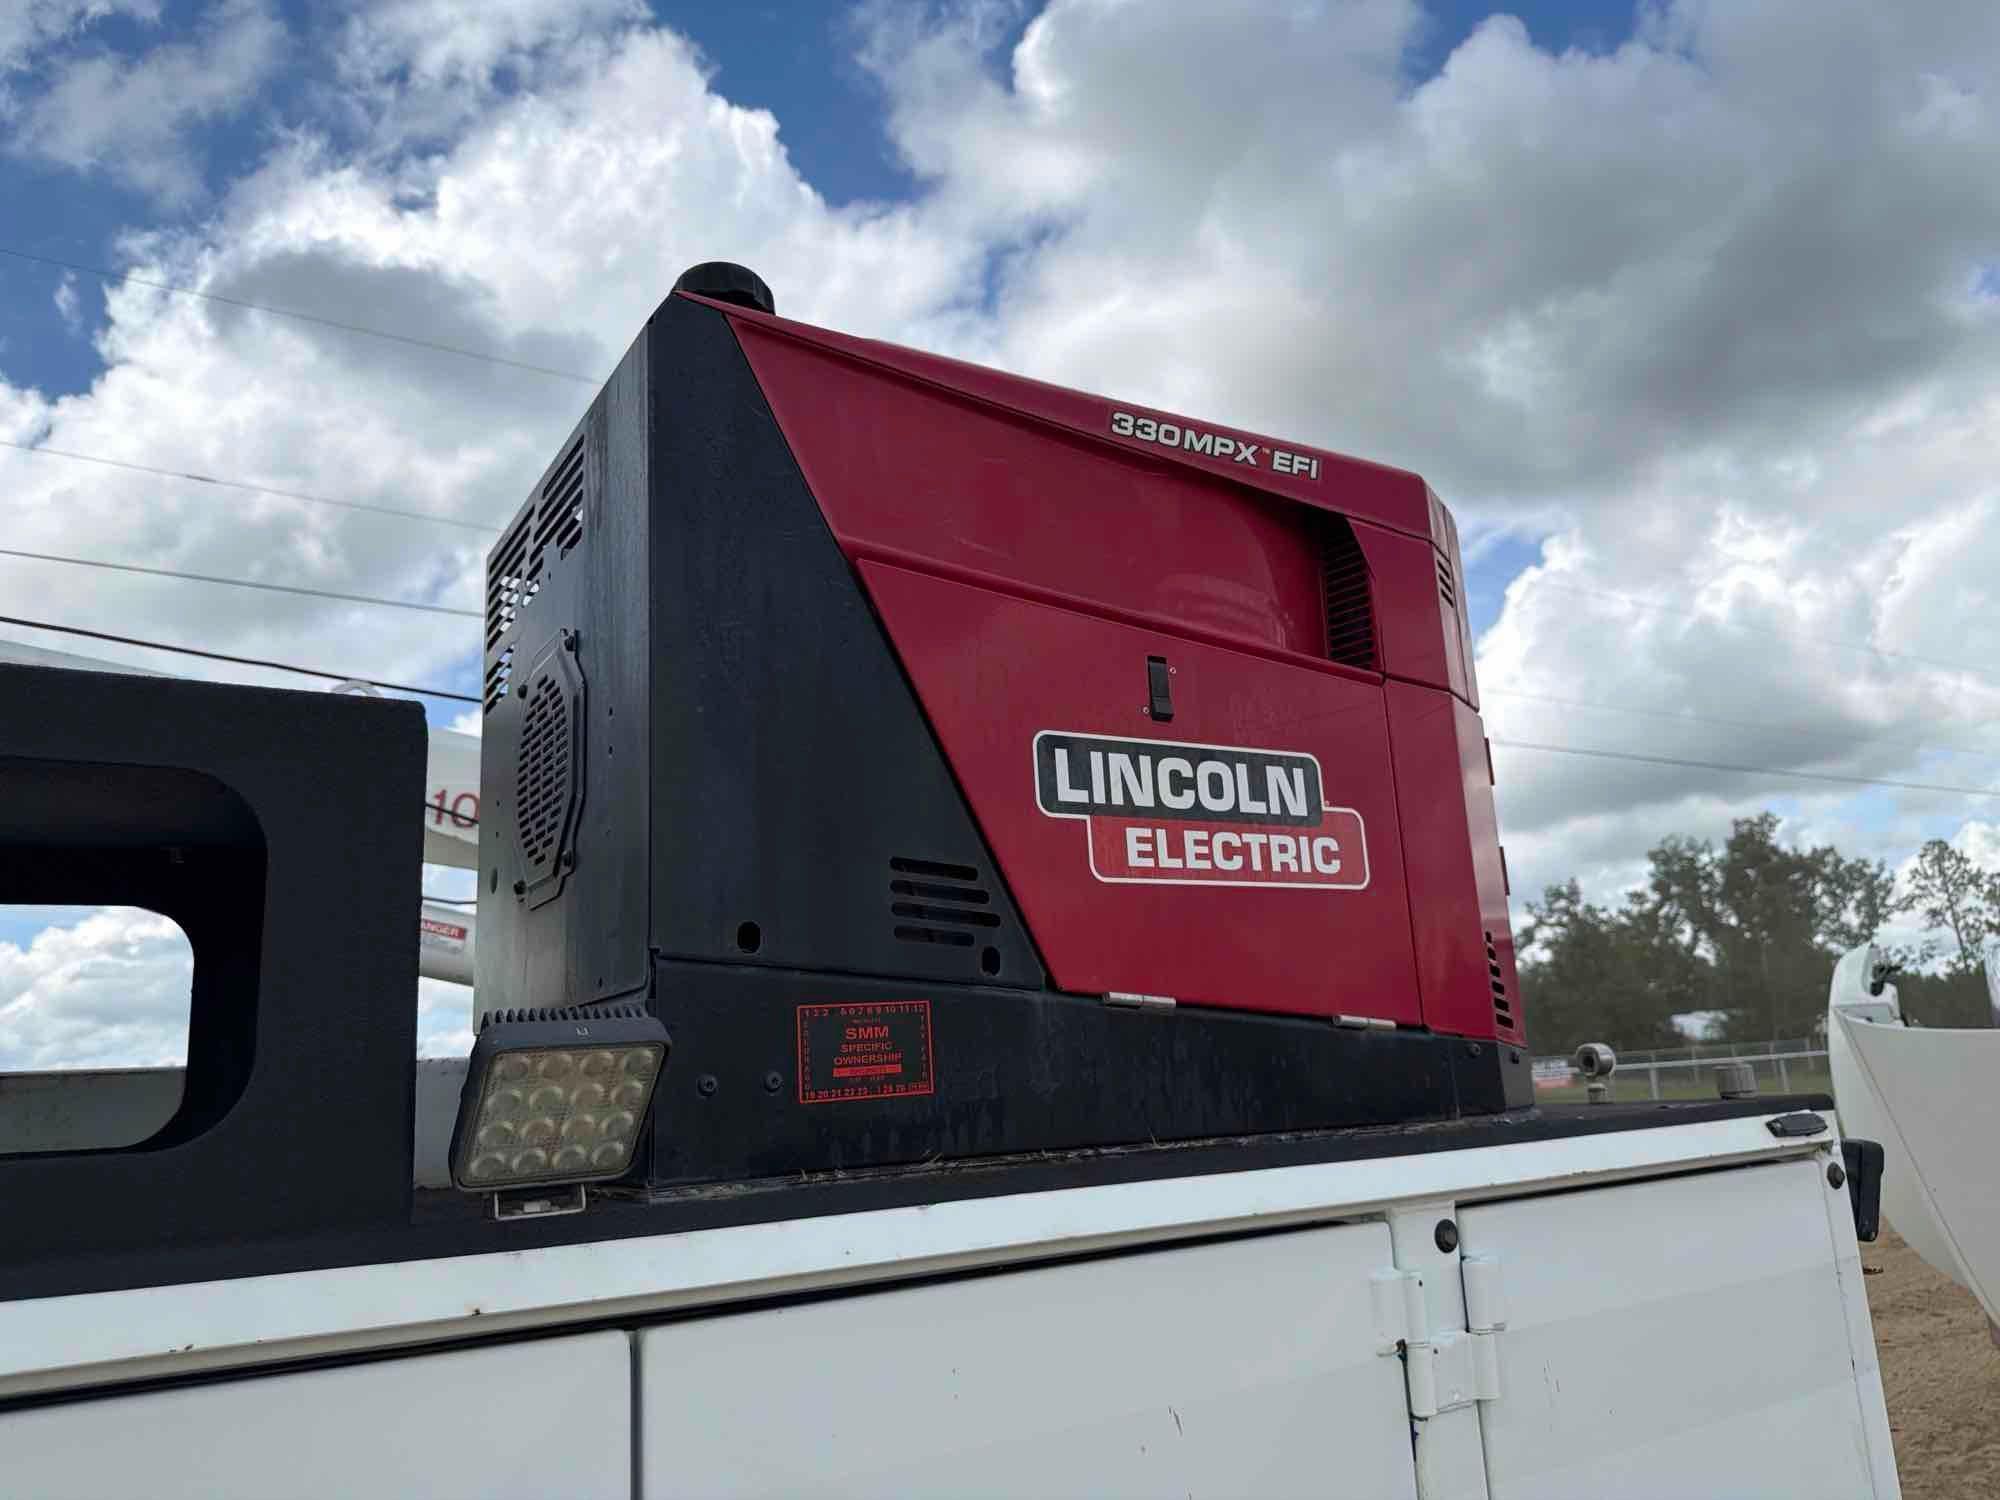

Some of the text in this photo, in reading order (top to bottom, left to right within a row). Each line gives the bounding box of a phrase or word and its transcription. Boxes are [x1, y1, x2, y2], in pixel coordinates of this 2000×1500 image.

[1272, 451, 1319, 480] EFI
[1054, 747, 1309, 817] LINCOLN
[1125, 827, 1341, 875] ELECTRIC
[421, 920, 460, 937] ANGER
[845, 1025, 889, 1040] SMM
[839, 1041, 894, 1053] SPECIFIC
[833, 1052, 903, 1065] OWNERSHIP
